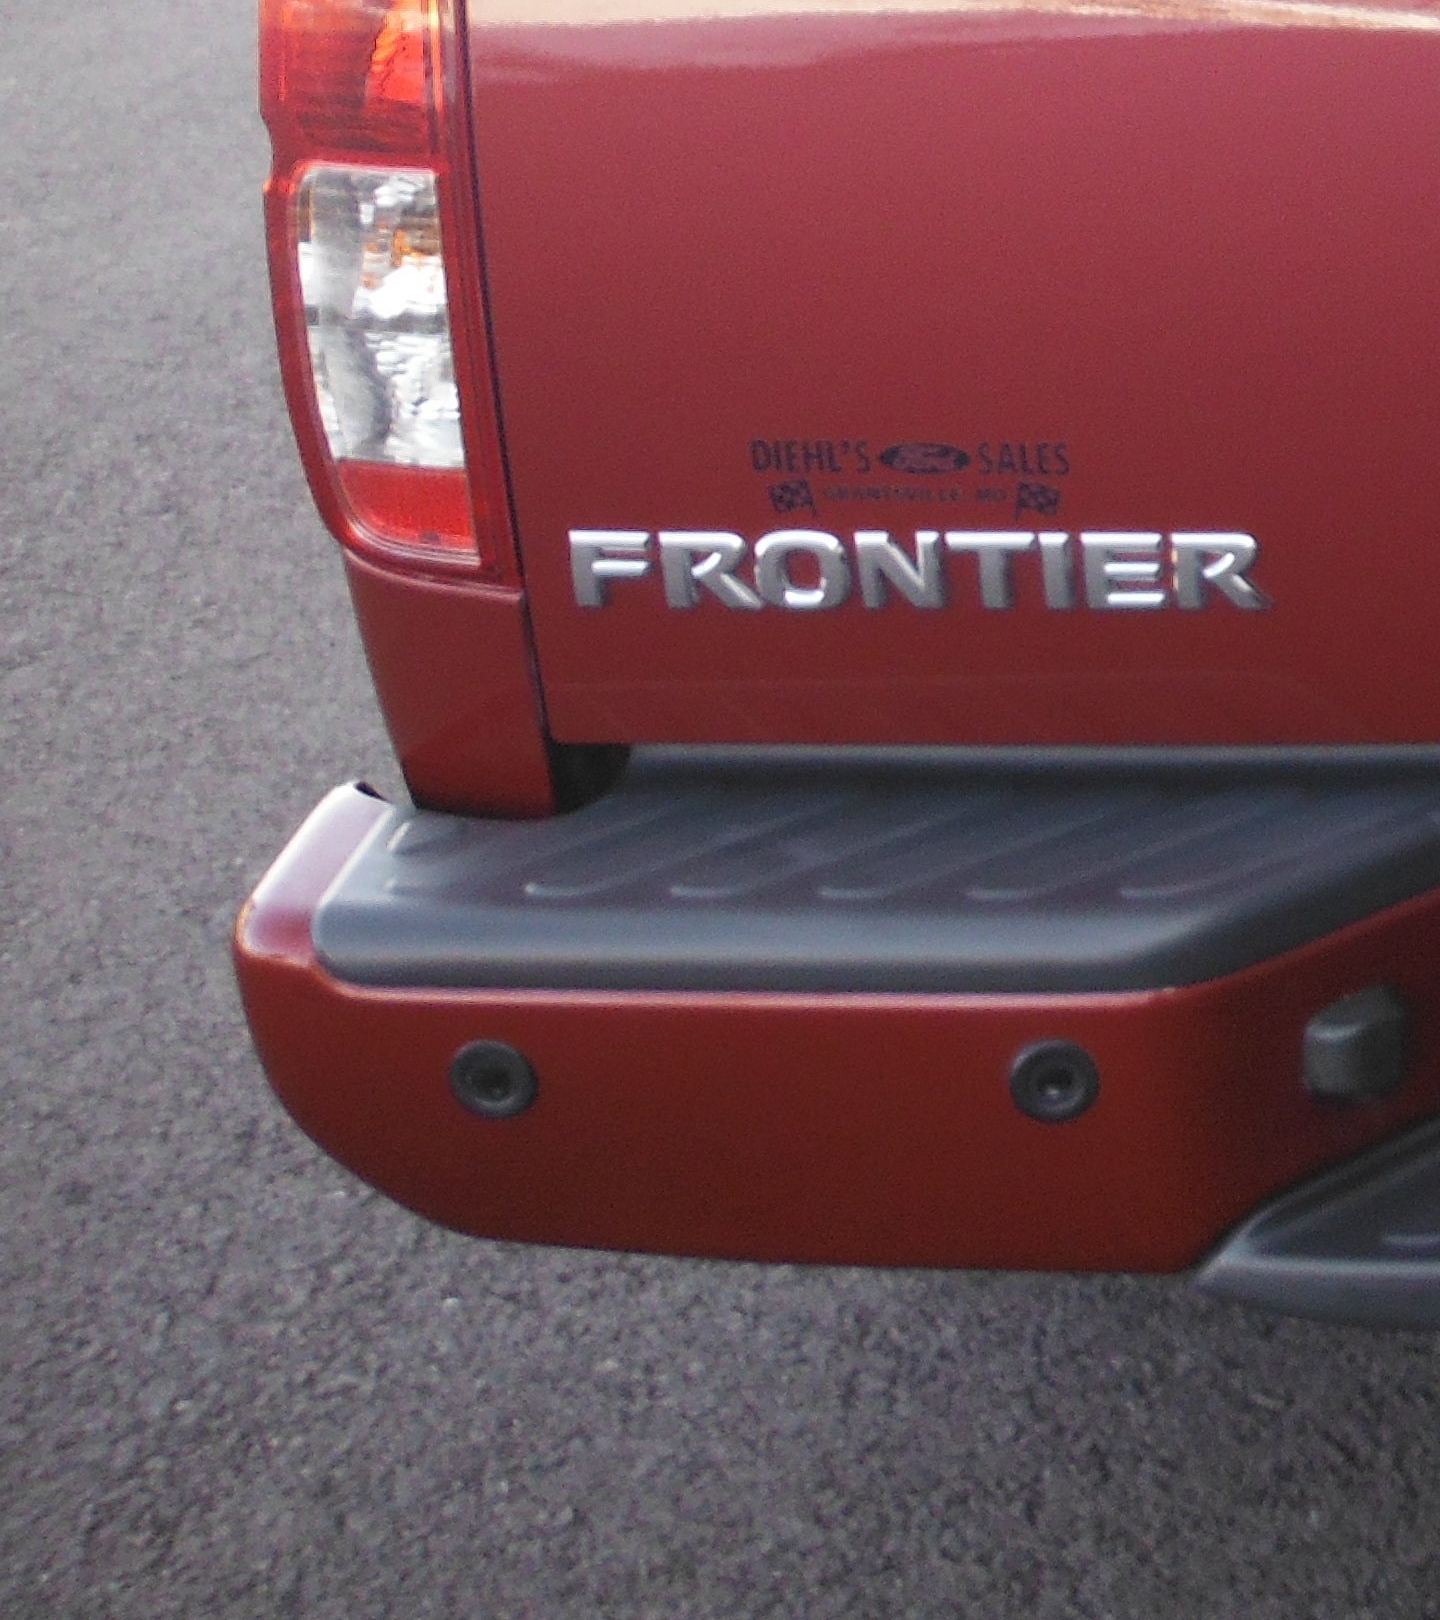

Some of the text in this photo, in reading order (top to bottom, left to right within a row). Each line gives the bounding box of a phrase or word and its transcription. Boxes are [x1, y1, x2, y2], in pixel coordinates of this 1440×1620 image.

[749, 438, 872, 474] DIEHL'S
[975, 440, 1070, 476] SALES
[567, 529, 1271, 611] FRONTIER
